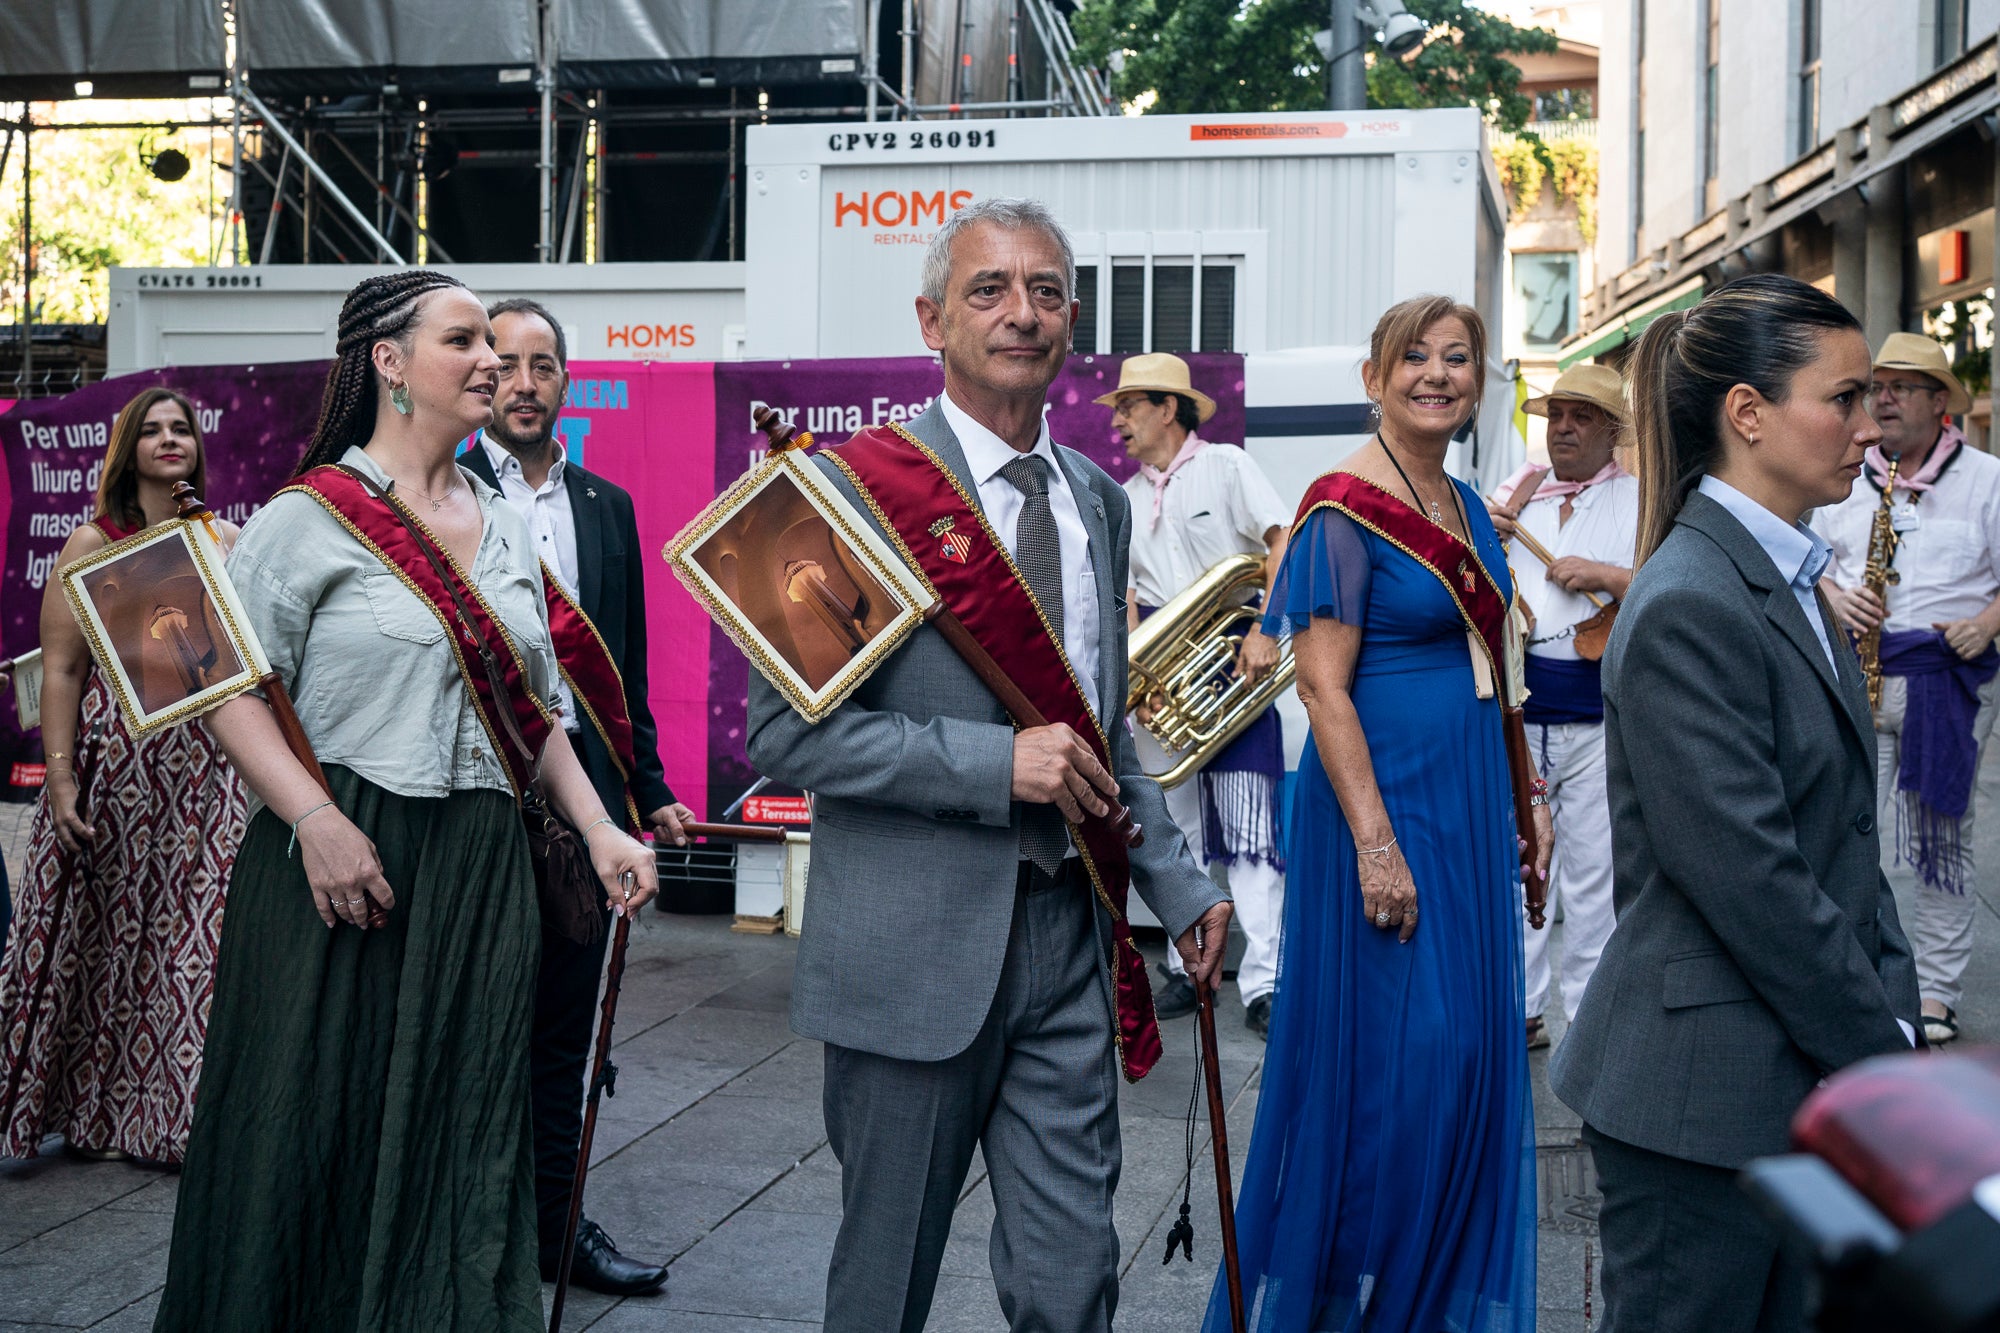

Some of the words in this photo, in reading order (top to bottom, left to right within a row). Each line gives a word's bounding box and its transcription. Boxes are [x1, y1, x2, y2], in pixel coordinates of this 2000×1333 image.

[829, 132, 897, 151] CPV2
[910, 129, 996, 149] 26091
[1202, 125, 1318, 137] homsrentals.com
[207, 274, 263, 288] 20001
[607, 324, 696, 348] HOMS
[566, 379, 629, 409] NEM
[807, 405, 862, 434] una
[20, 420, 59, 450] Per
[64, 422, 107, 449] una
[31, 461, 83, 494] lliure
[30, 505, 95, 538] mascli
[761, 808, 810, 820] Terrassa
